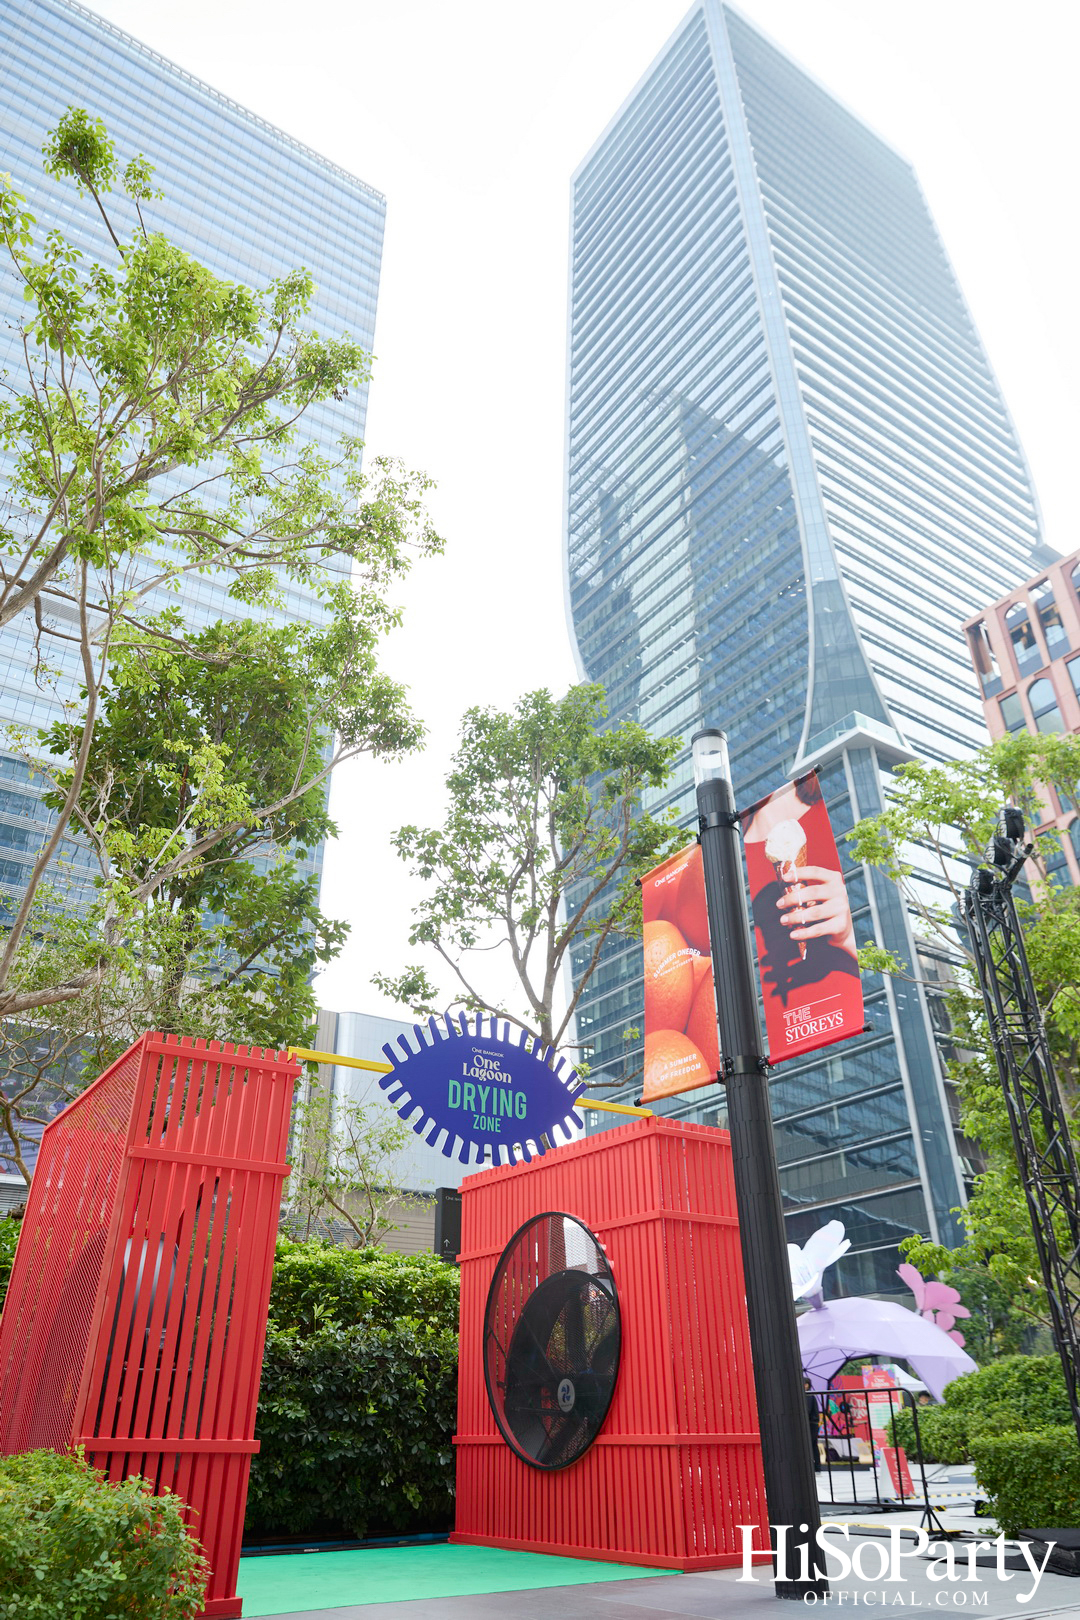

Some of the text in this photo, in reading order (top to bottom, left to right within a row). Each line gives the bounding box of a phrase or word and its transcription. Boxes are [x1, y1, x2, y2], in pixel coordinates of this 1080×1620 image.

[653, 947, 701, 979] SUMMER ONEDER
[783, 1006, 811, 1026] THE
[785, 1012, 844, 1042] STOREYS
[473, 1054, 501, 1071] One
[670, 1053, 697, 1069] SUMMER
[462, 1062, 512, 1084] Lagoon
[660, 1062, 702, 1081] OF FREEDOM
[448, 1079, 527, 1120] DRYING
[473, 1114, 502, 1133] ZONE
